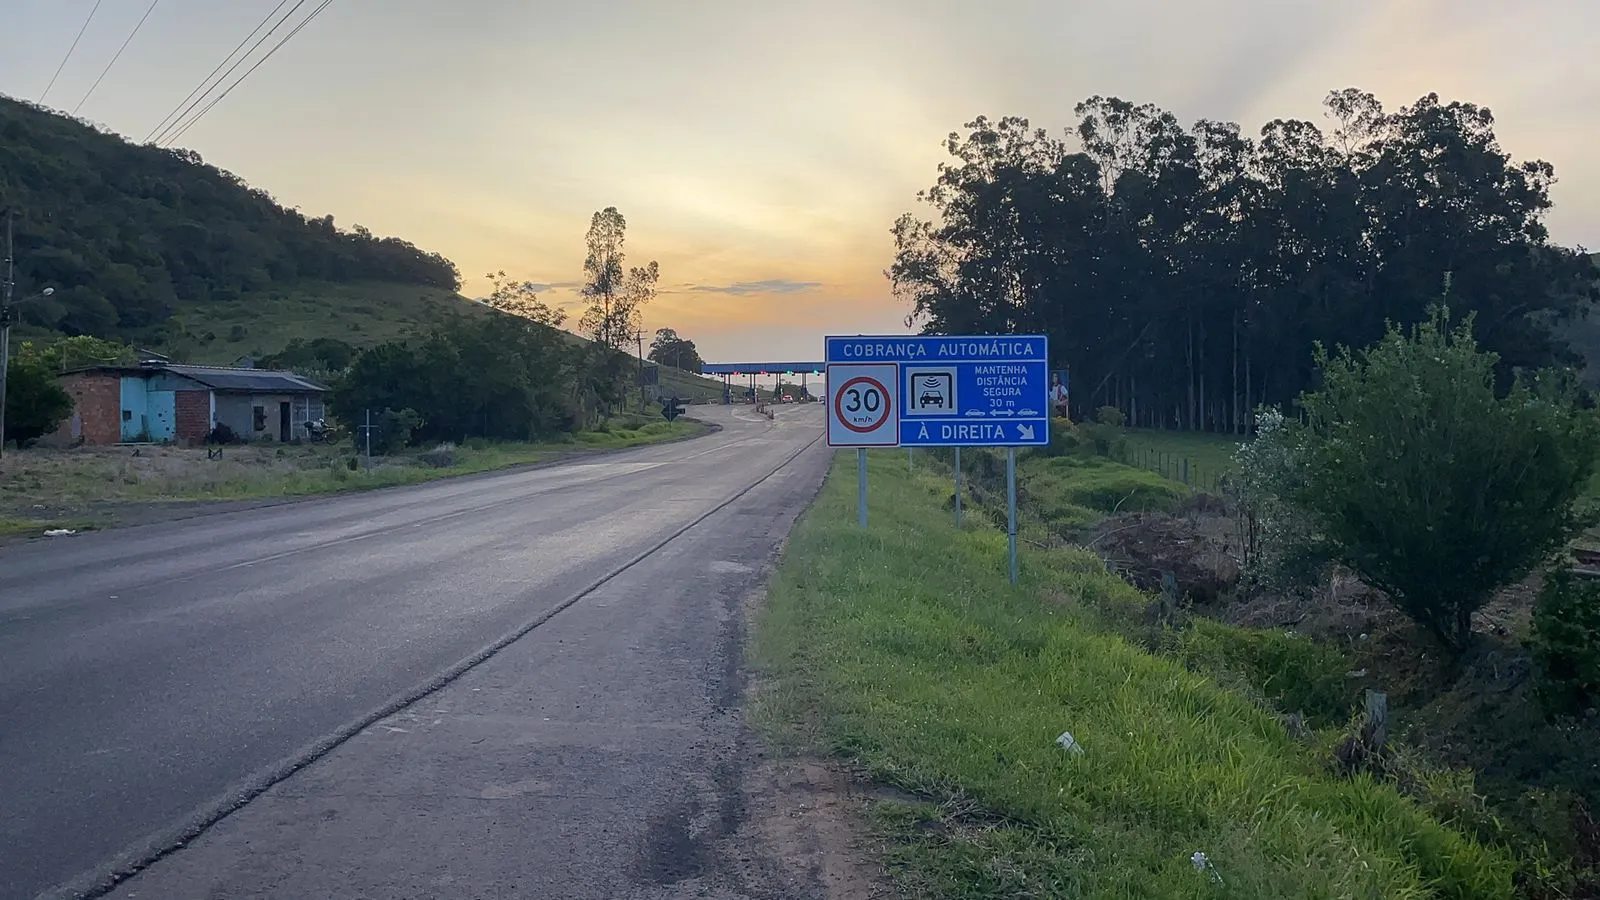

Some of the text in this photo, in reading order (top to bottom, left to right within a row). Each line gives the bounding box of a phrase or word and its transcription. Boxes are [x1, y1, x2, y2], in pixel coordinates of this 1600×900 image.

[843, 339, 1034, 359] COBRANÇA AUTOMÁTICA
[975, 365, 1028, 375] MANTENHA
[976, 375, 1028, 386] DISTÂNCIA
[983, 387, 1022, 397] SEGURA
[846, 388, 880, 412] 30
[989, 398, 1004, 407] 30
[853, 415, 873, 424] km/h
[918, 421, 1006, 440] À DIREITA
